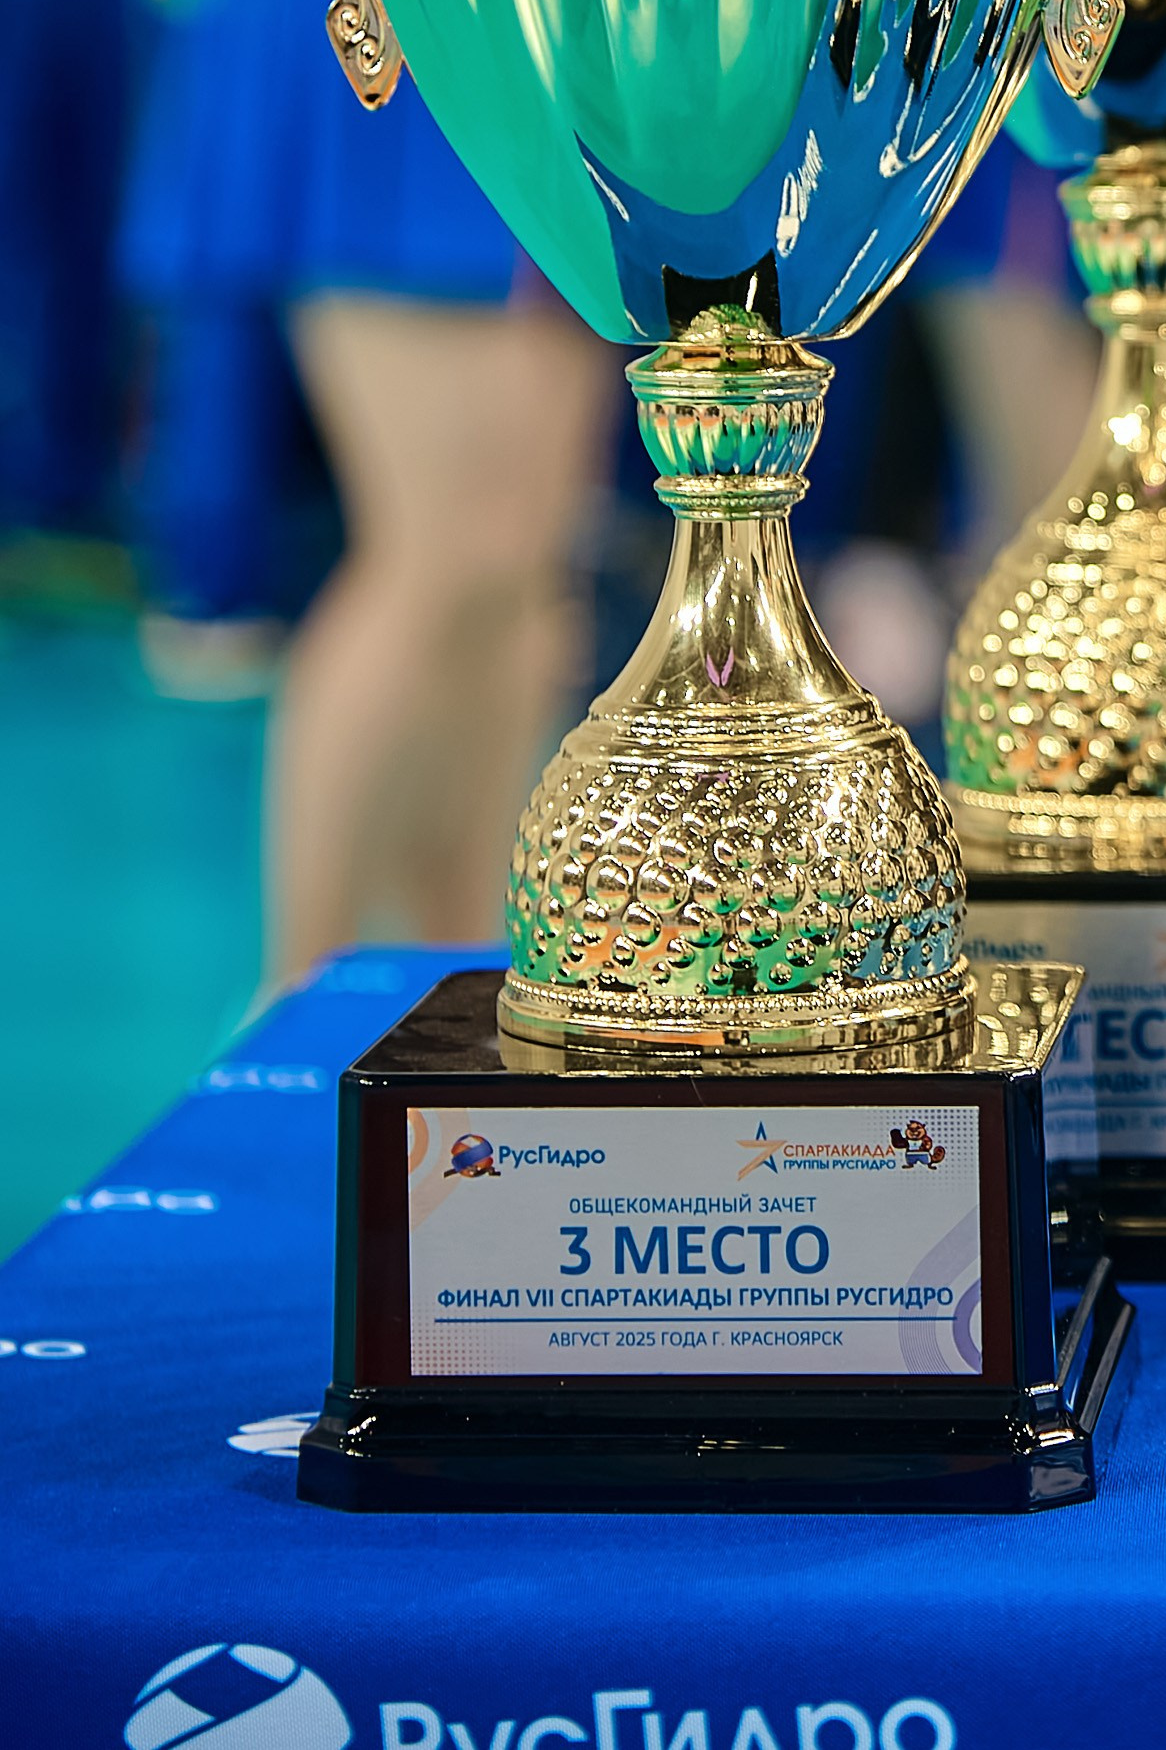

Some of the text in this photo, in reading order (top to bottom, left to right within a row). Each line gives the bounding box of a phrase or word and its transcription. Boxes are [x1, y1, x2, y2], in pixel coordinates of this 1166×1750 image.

[498, 1144, 605, 1170] РусГидро
[783, 1144, 896, 1159] СПАРТАКИАДА
[783, 1158, 897, 1172] ГРУППЫ РУСГИДРО
[569, 1193, 817, 1216] ОБЩЕКОМАНДНЫЙ ЗАЧЕТ
[559, 1225, 830, 1276] 3 МЕСТО
[437, 1286, 954, 1311] ФИНАЛ VII СПАРТАКИАДЫ ГРУППЫ РУСГИДРО
[548, 1330, 844, 1348] АВГУСТ 2025 ГОДА Г. КРАСНОЯРСК
[379, 1689, 957, 1750] РГиро
